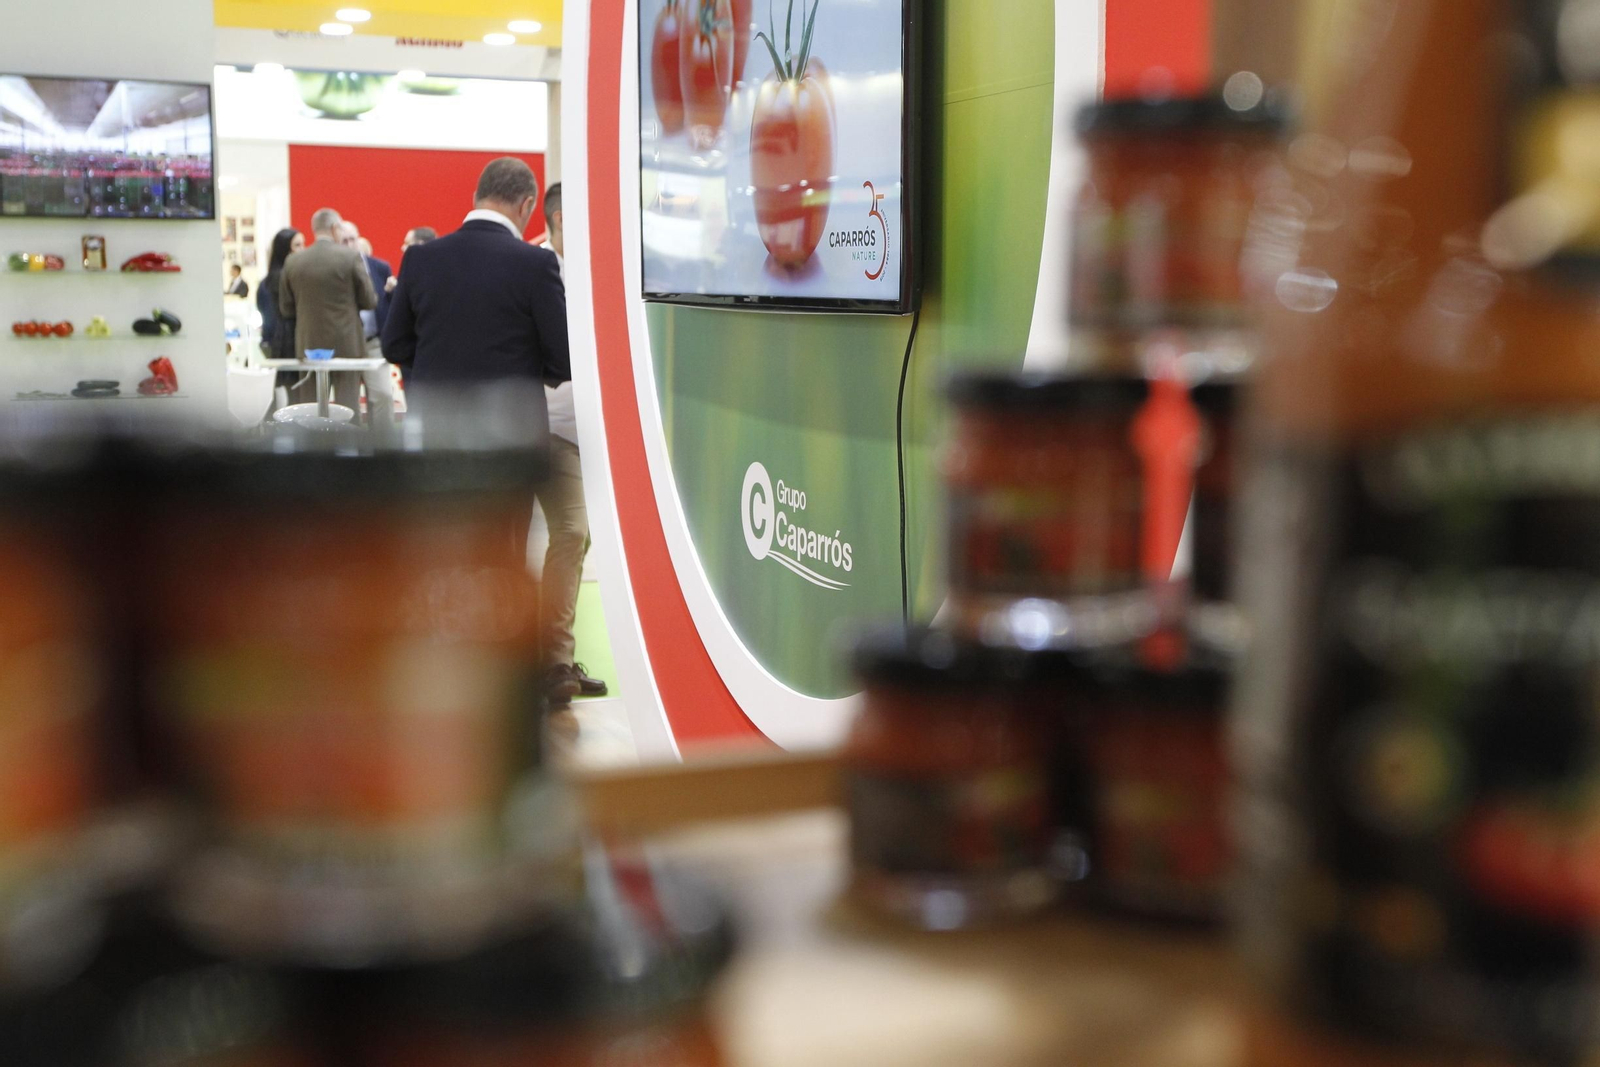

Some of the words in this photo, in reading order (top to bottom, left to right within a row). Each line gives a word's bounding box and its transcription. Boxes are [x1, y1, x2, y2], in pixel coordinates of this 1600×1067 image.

[829, 225, 876, 248] CAPARRÓS
[851, 251, 876, 261] NATURE
[776, 479, 807, 513] Grupo
[775, 511, 853, 572] Caparrós
